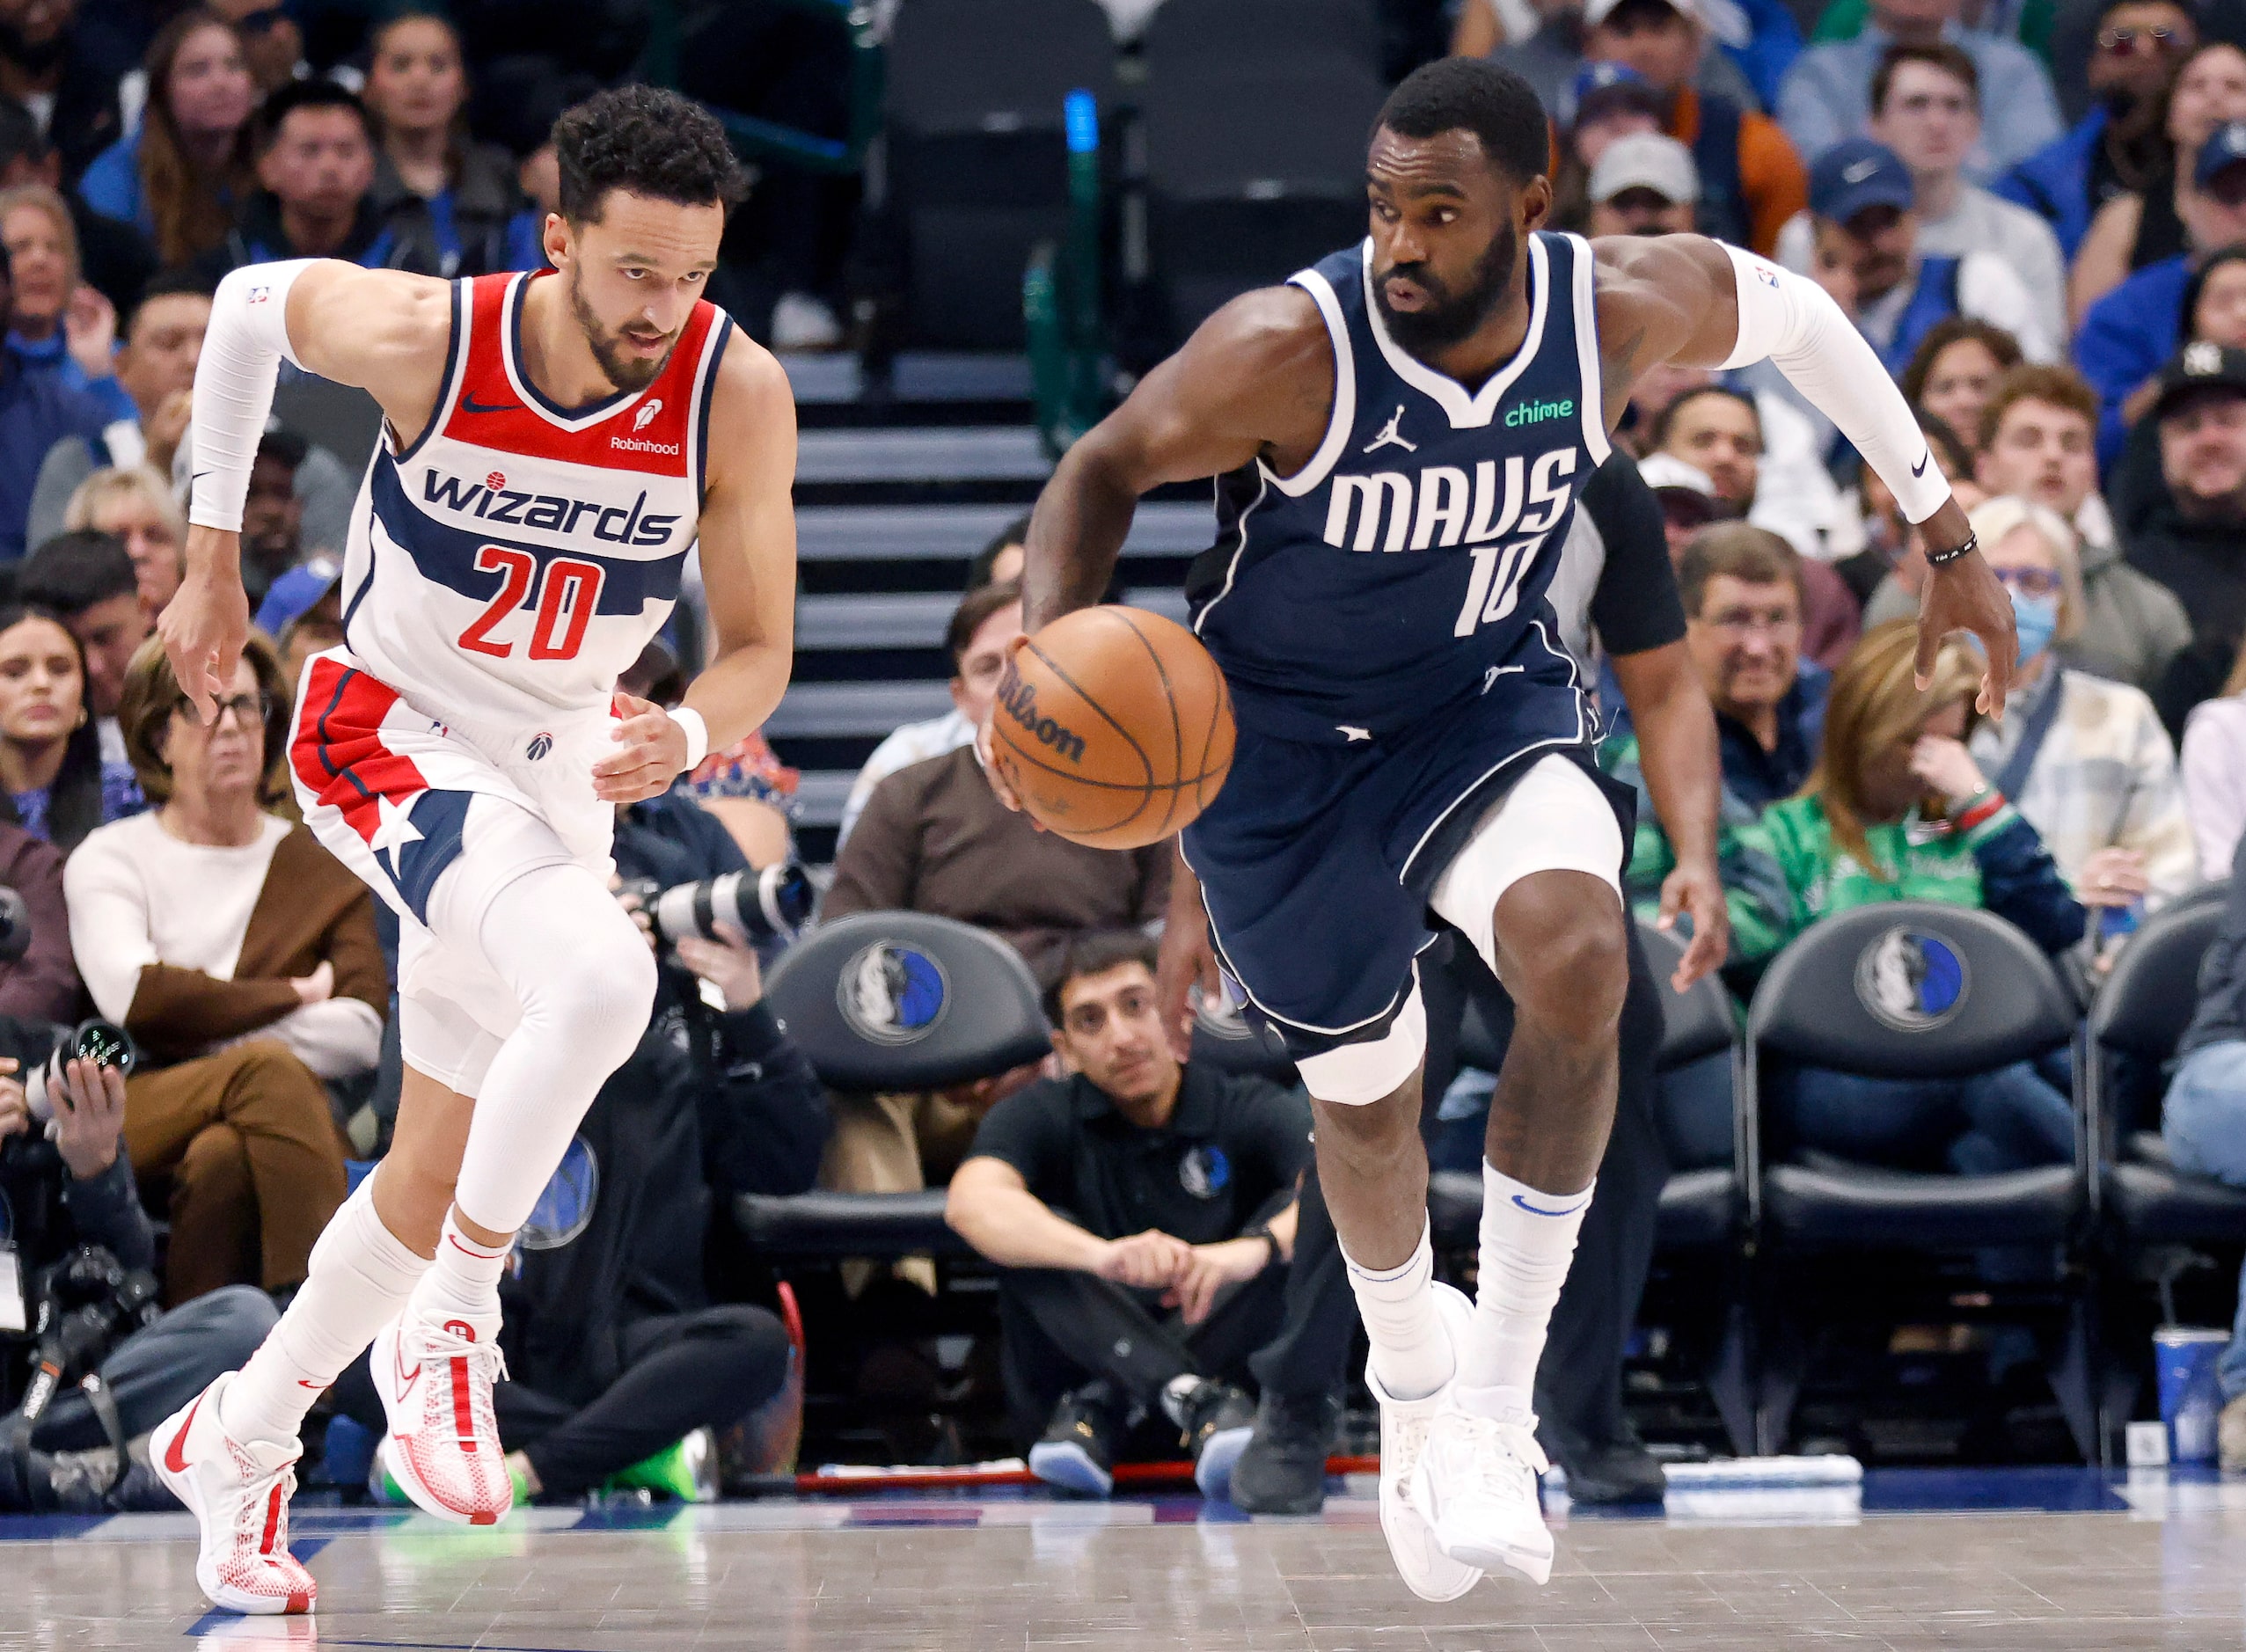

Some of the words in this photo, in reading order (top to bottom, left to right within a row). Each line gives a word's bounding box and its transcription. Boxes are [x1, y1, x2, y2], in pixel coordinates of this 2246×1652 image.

[611, 436, 679, 456] Robinhood
[1505, 399, 1574, 428] chime
[424, 468, 684, 546] wizards
[1323, 446, 1577, 553] MAVS
[457, 545, 605, 661] 20
[1453, 532, 1549, 638] 10
